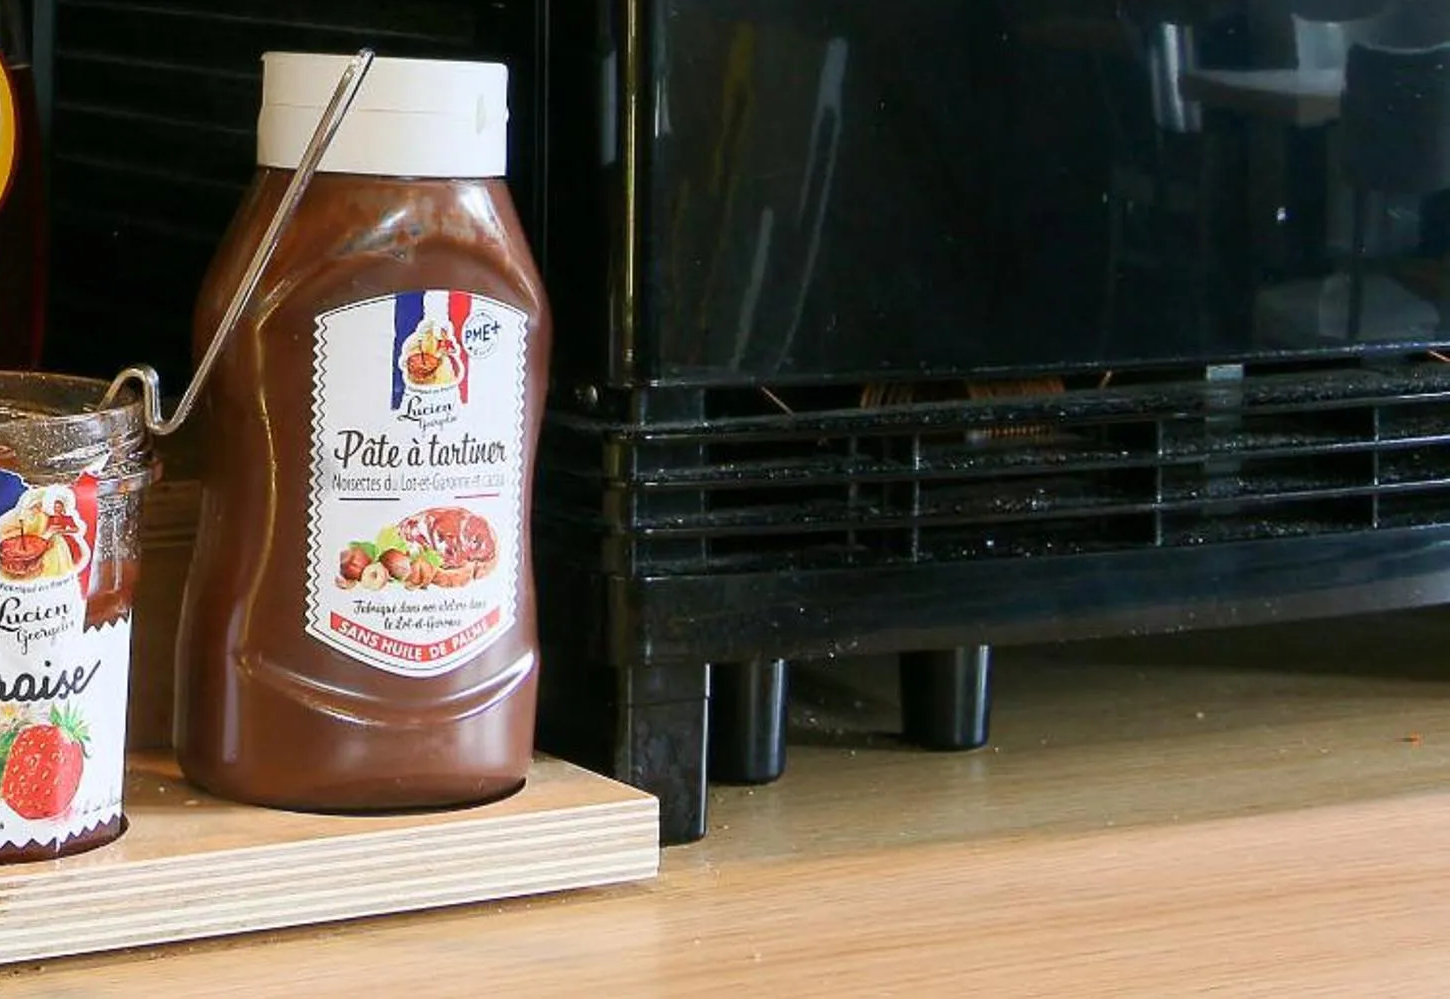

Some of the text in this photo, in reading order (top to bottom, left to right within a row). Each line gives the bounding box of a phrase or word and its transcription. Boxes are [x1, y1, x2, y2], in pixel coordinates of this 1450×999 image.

[465, 320, 501, 344] PME+
[397, 395, 453, 421] Lucien
[334, 429, 508, 469] Pâte à tartiner
[338, 618, 380, 647] SANS
[381, 639, 423, 662] HUILE
[429, 642, 448, 659] DE
